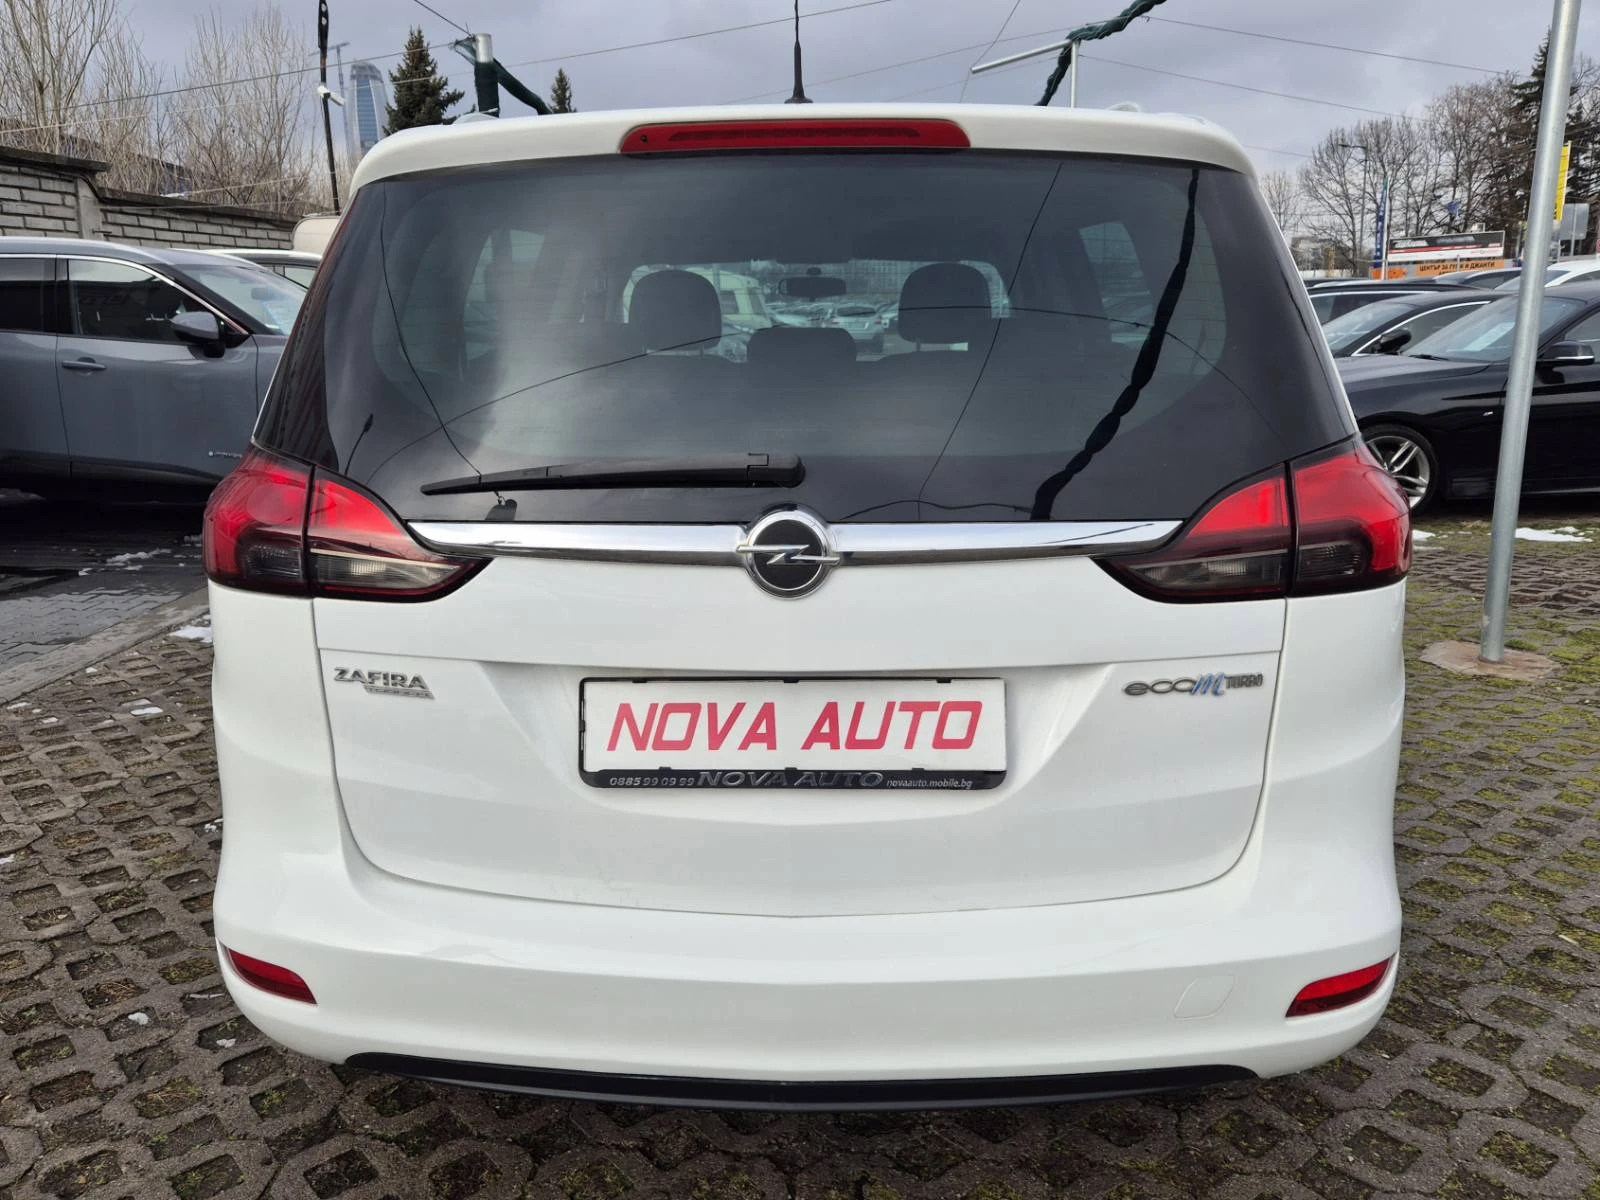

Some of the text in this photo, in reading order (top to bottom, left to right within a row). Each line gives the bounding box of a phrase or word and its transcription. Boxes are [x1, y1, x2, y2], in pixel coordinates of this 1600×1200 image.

[334, 667, 429, 690] ZAFIRA
[606, 700, 983, 752] NOVA AUTO
[609, 777, 641, 786] 0885
[697, 771, 788, 786] NOVA
[793, 771, 884, 787] AUTO
[886, 777, 973, 790] novaauto.mobile.bg
